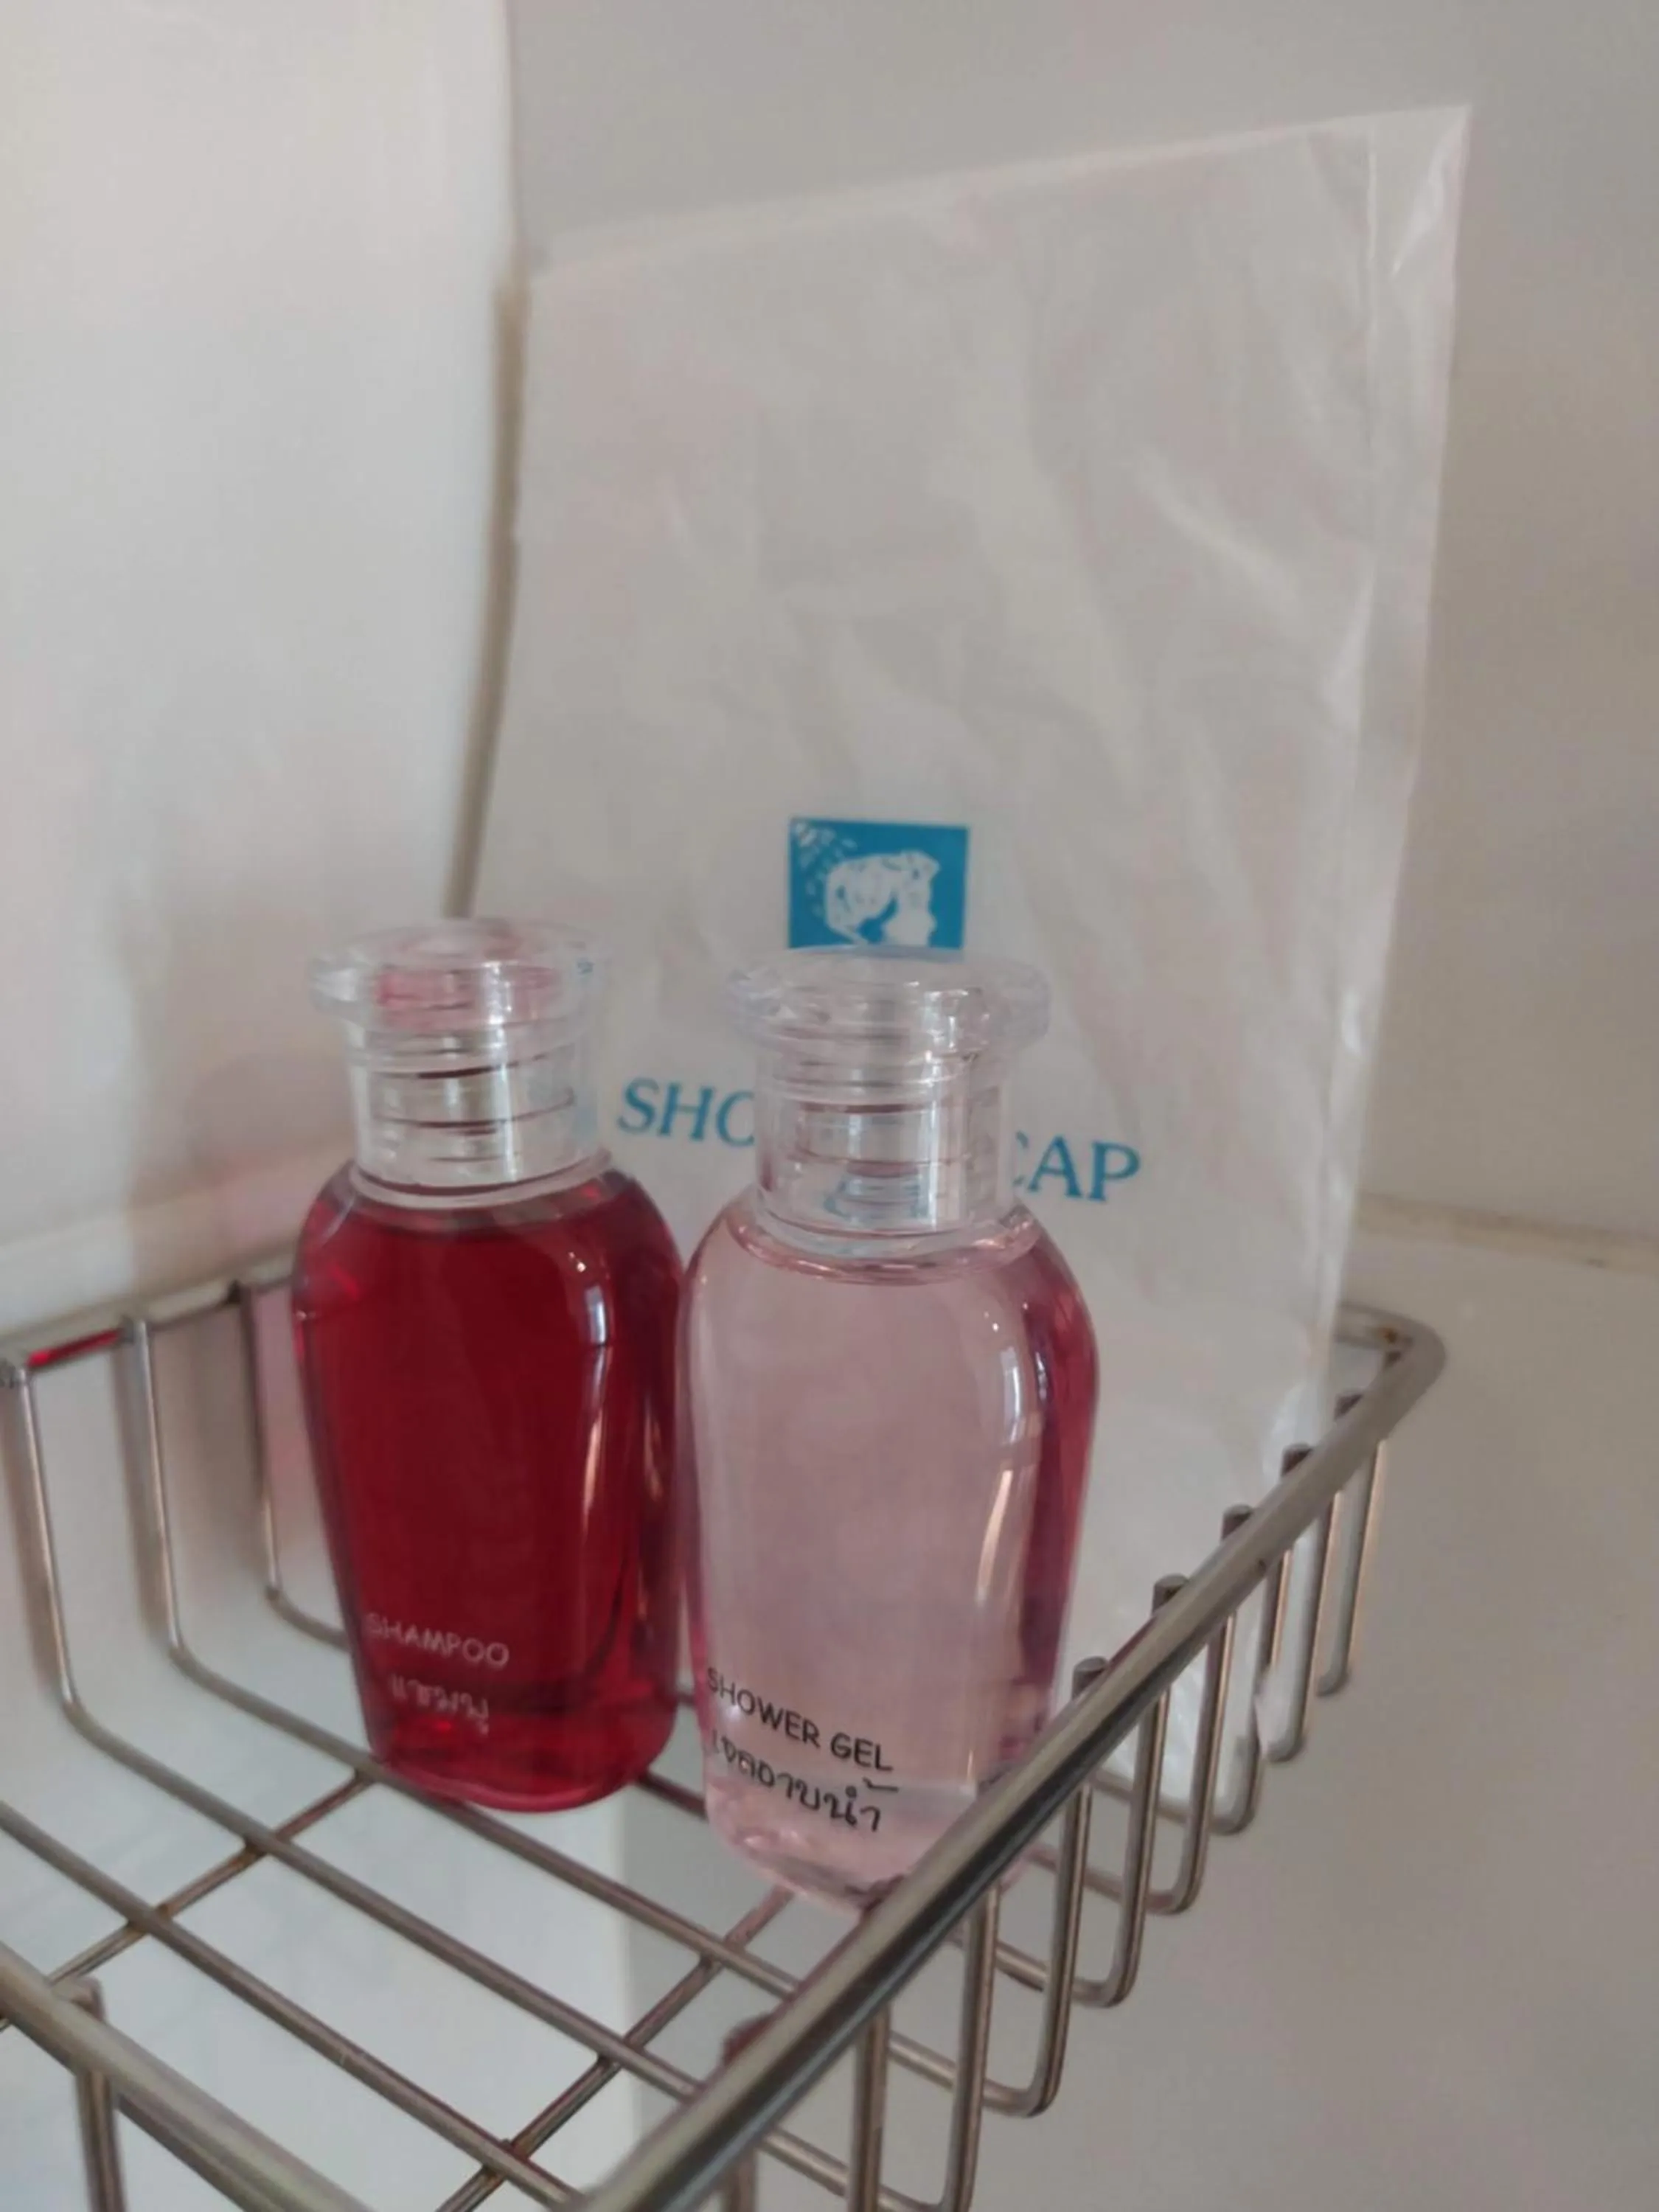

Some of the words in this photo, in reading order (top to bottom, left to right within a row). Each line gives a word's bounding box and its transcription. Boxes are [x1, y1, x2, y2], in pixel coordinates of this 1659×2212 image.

[617, 1077, 755, 1147] SHO
[1012, 1130, 1141, 1202] AP
[366, 1612, 509, 1668] SHAMPOO
[708, 1666, 821, 1748] SHOWER
[830, 1732, 894, 1773] GEL
